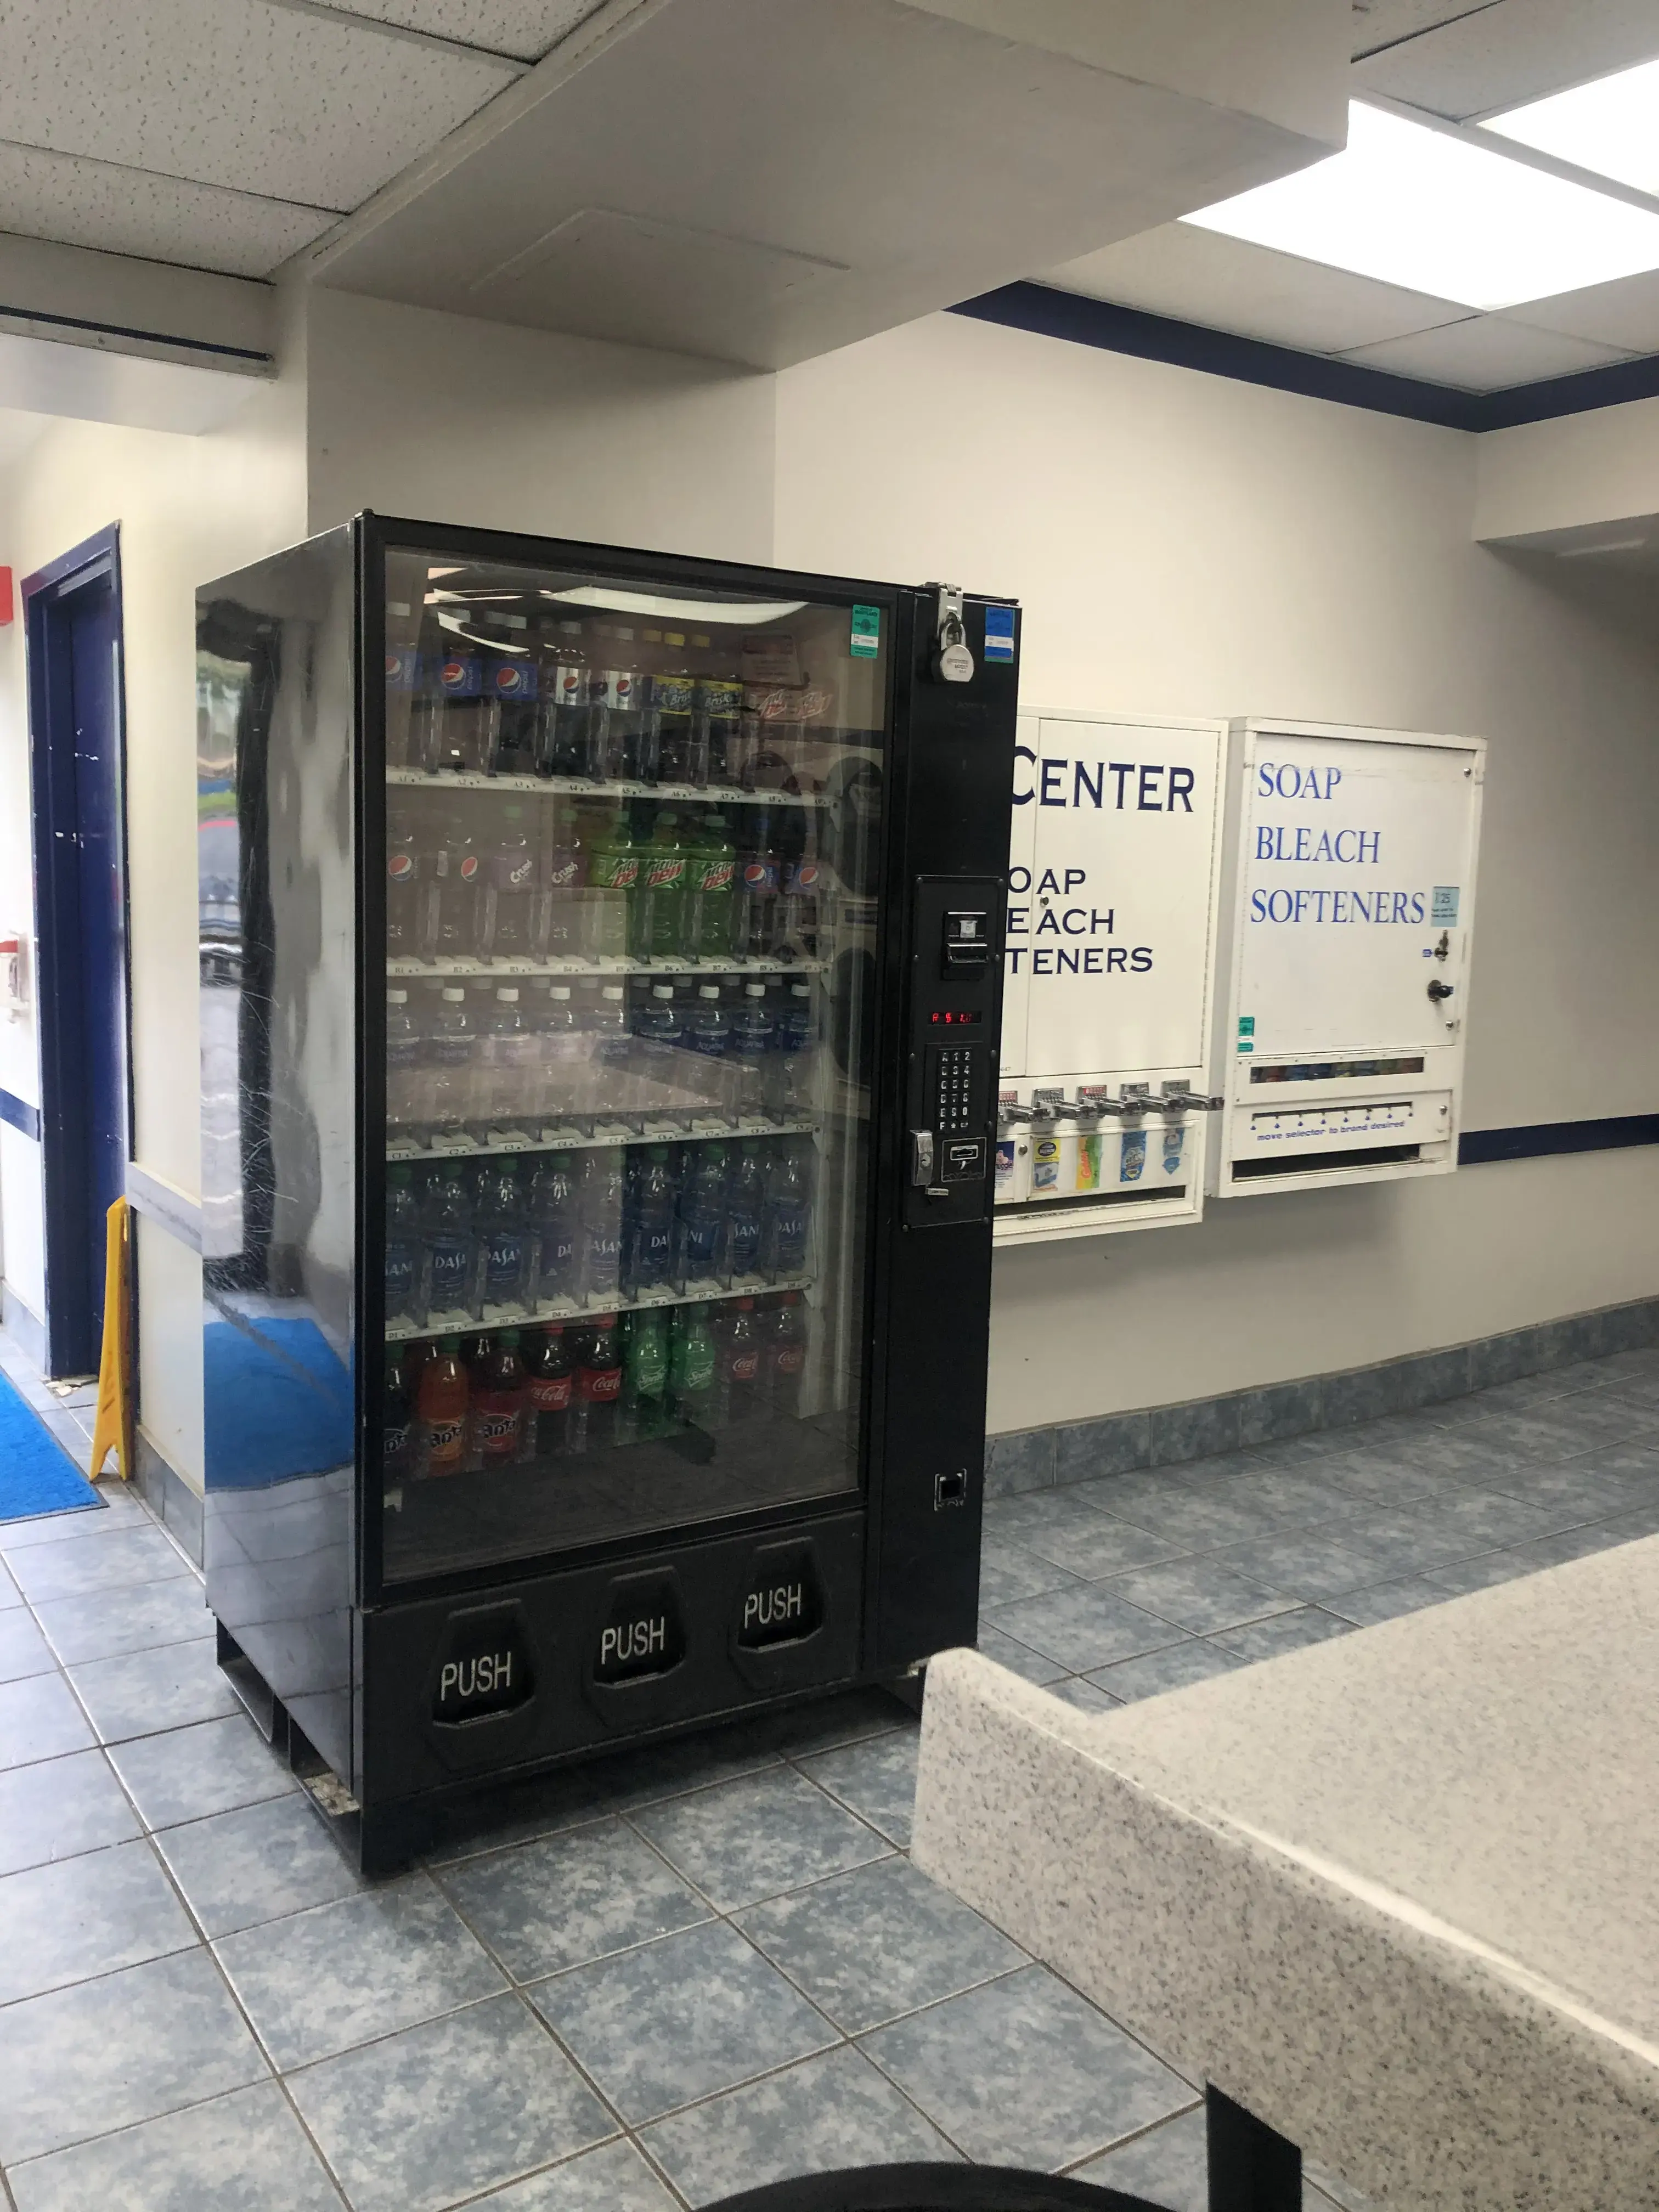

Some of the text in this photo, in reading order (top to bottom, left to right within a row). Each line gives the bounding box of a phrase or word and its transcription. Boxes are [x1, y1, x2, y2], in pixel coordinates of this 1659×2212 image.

[1258, 763, 1342, 799] SOAP
[1255, 827, 1381, 864] BLEACH
[510, 859, 533, 884] Crush
[551, 861, 579, 884] Crush
[1250, 889, 1426, 924] SOFTENERS
[964, 1051, 970, 1061] 2
[939, 1122, 945, 1130] F
[940, 1108, 946, 1118] E
[951, 1107, 957, 1116] 9
[744, 1584, 802, 1629] PUSH
[601, 1616, 665, 1664] PUSH
[441, 1651, 512, 1701] PUSH
